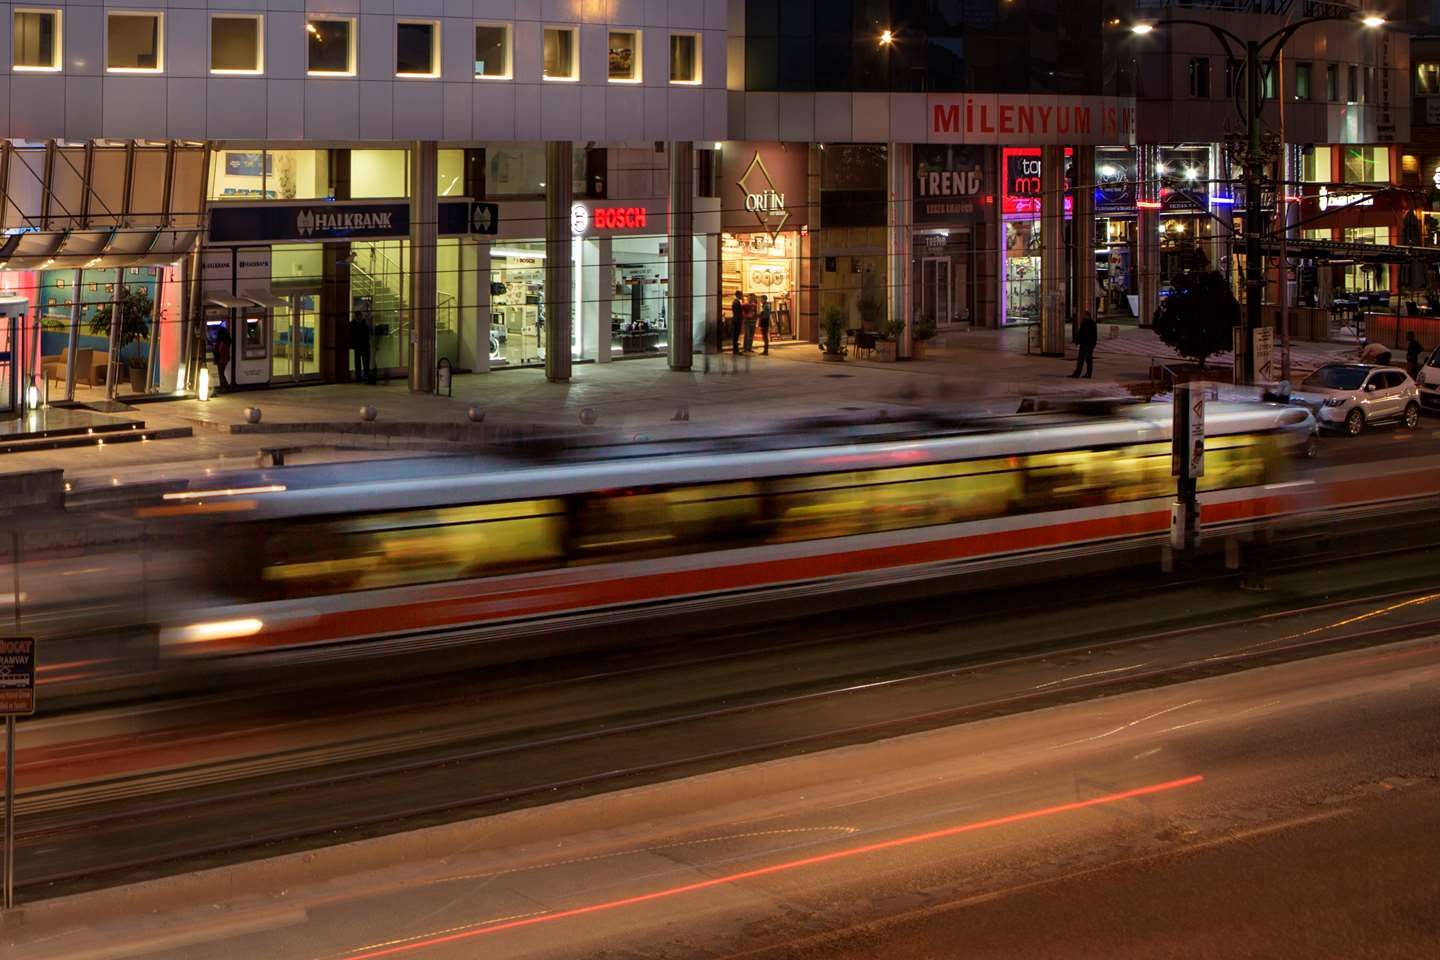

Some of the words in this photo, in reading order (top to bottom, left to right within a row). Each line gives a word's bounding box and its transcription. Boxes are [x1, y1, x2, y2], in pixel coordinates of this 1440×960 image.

[933, 99, 1091, 135] MİLENYUM
[920, 171, 980, 196] TREND
[315, 212, 393, 231] HALKBANK
[593, 207, 647, 229] BOSCH
